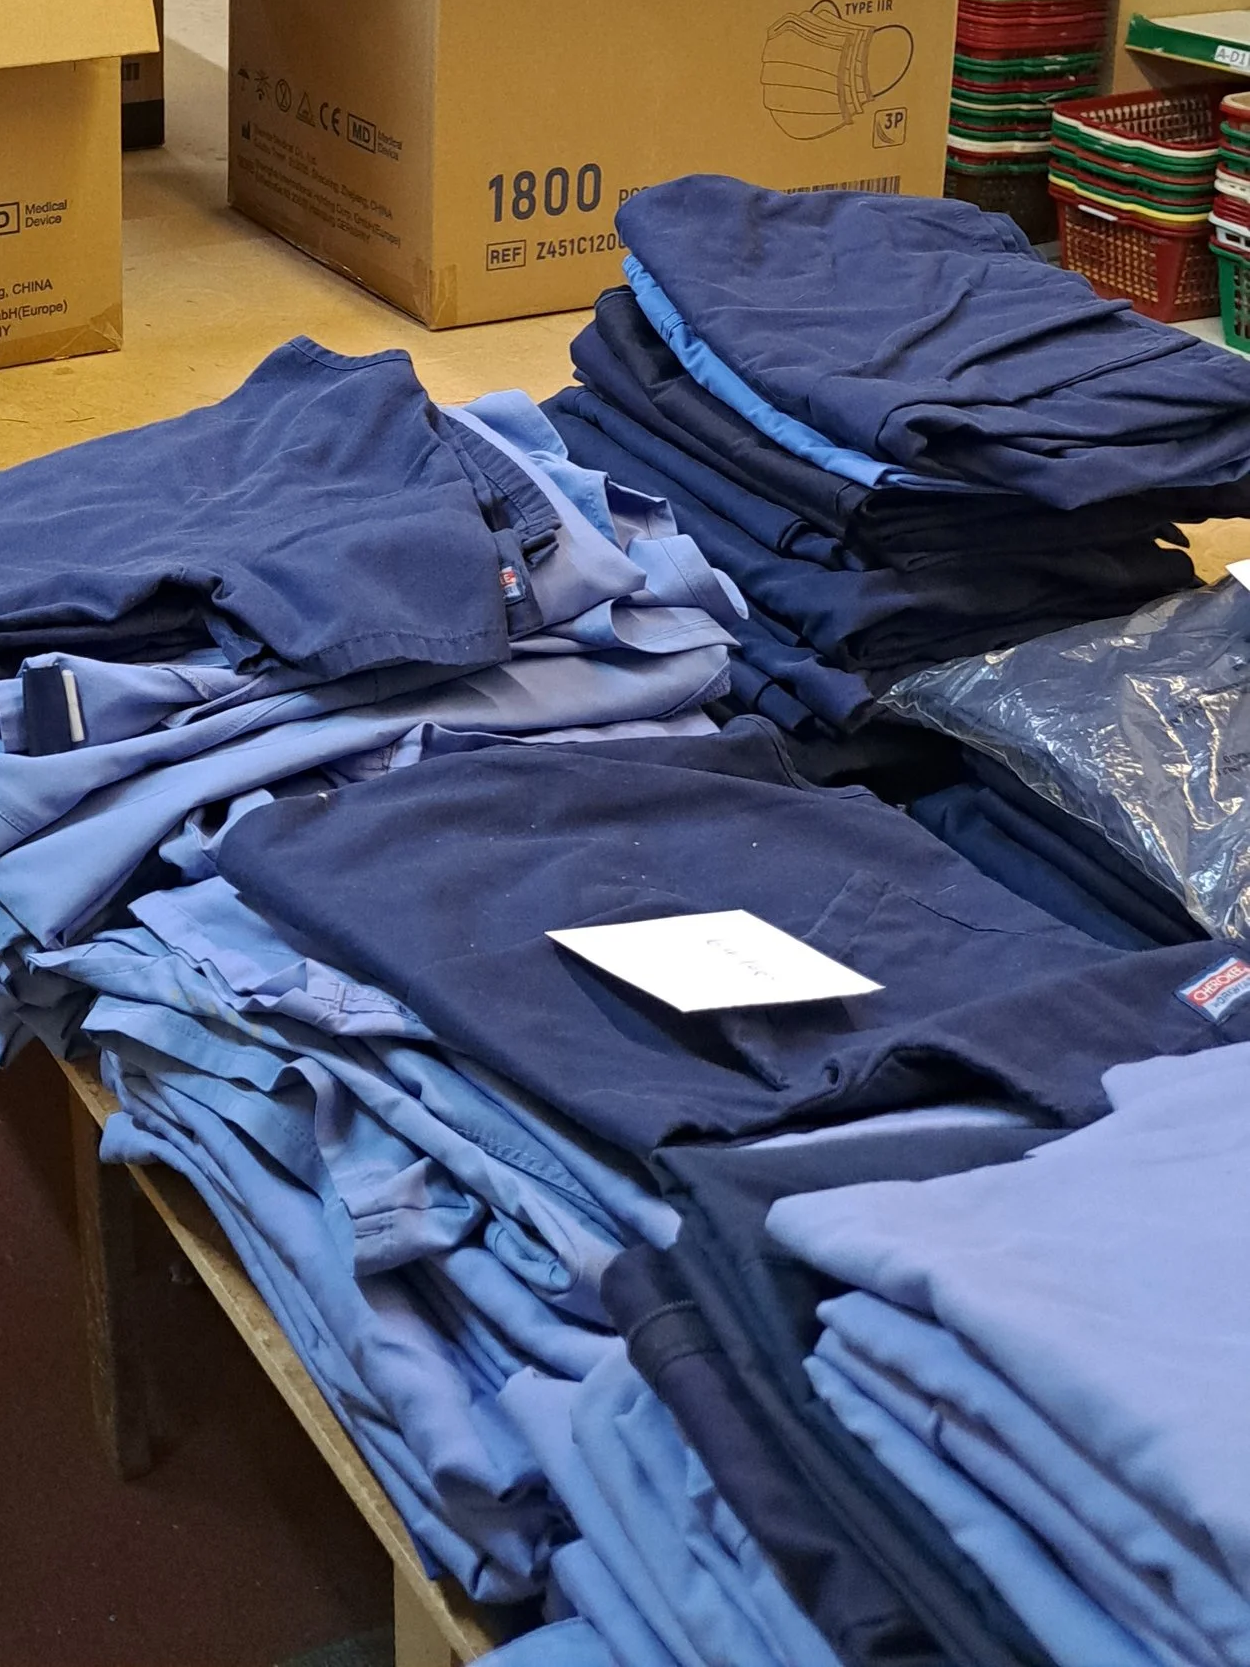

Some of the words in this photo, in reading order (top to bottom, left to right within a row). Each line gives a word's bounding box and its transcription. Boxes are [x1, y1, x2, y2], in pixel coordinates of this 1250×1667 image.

[844, 0, 873, 16] TYPE
[884, 111, 904, 130] 3P
[351, 121, 371, 144] MD
[488, 163, 602, 223] 1800
[24, 199, 68, 216] Medical
[24, 214, 62, 229] Device
[490, 246, 523, 265] REF
[12, 278, 54, 295] CHINA
[1193, 965, 1245, 1002] CHEROKEE
